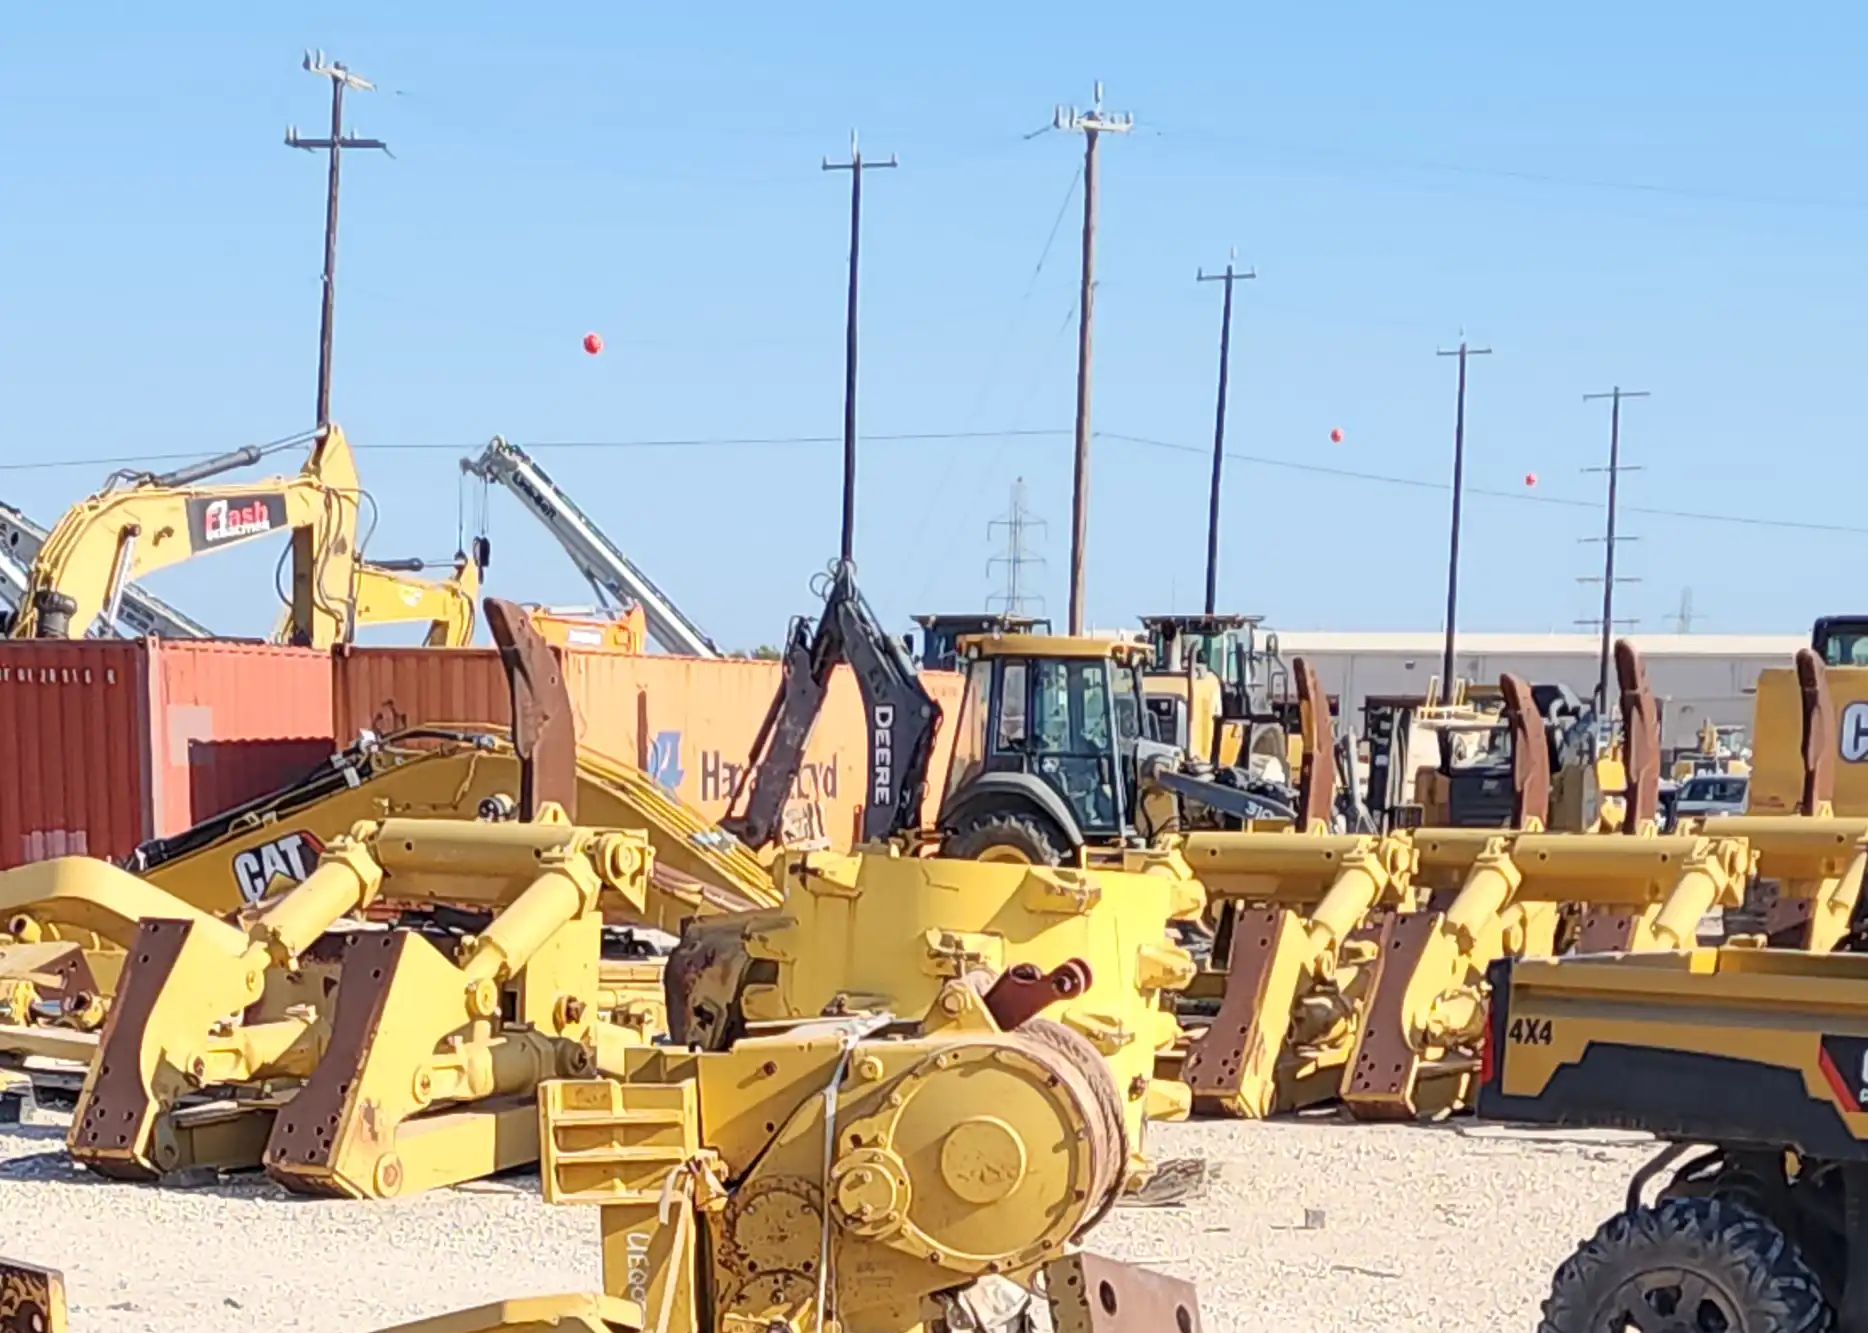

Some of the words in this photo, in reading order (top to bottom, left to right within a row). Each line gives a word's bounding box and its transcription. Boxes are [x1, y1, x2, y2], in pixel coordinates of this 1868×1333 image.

[874, 705, 894, 805] DEERE
[234, 834, 305, 901] CAT
[1509, 1018, 1552, 1046] 4X4
